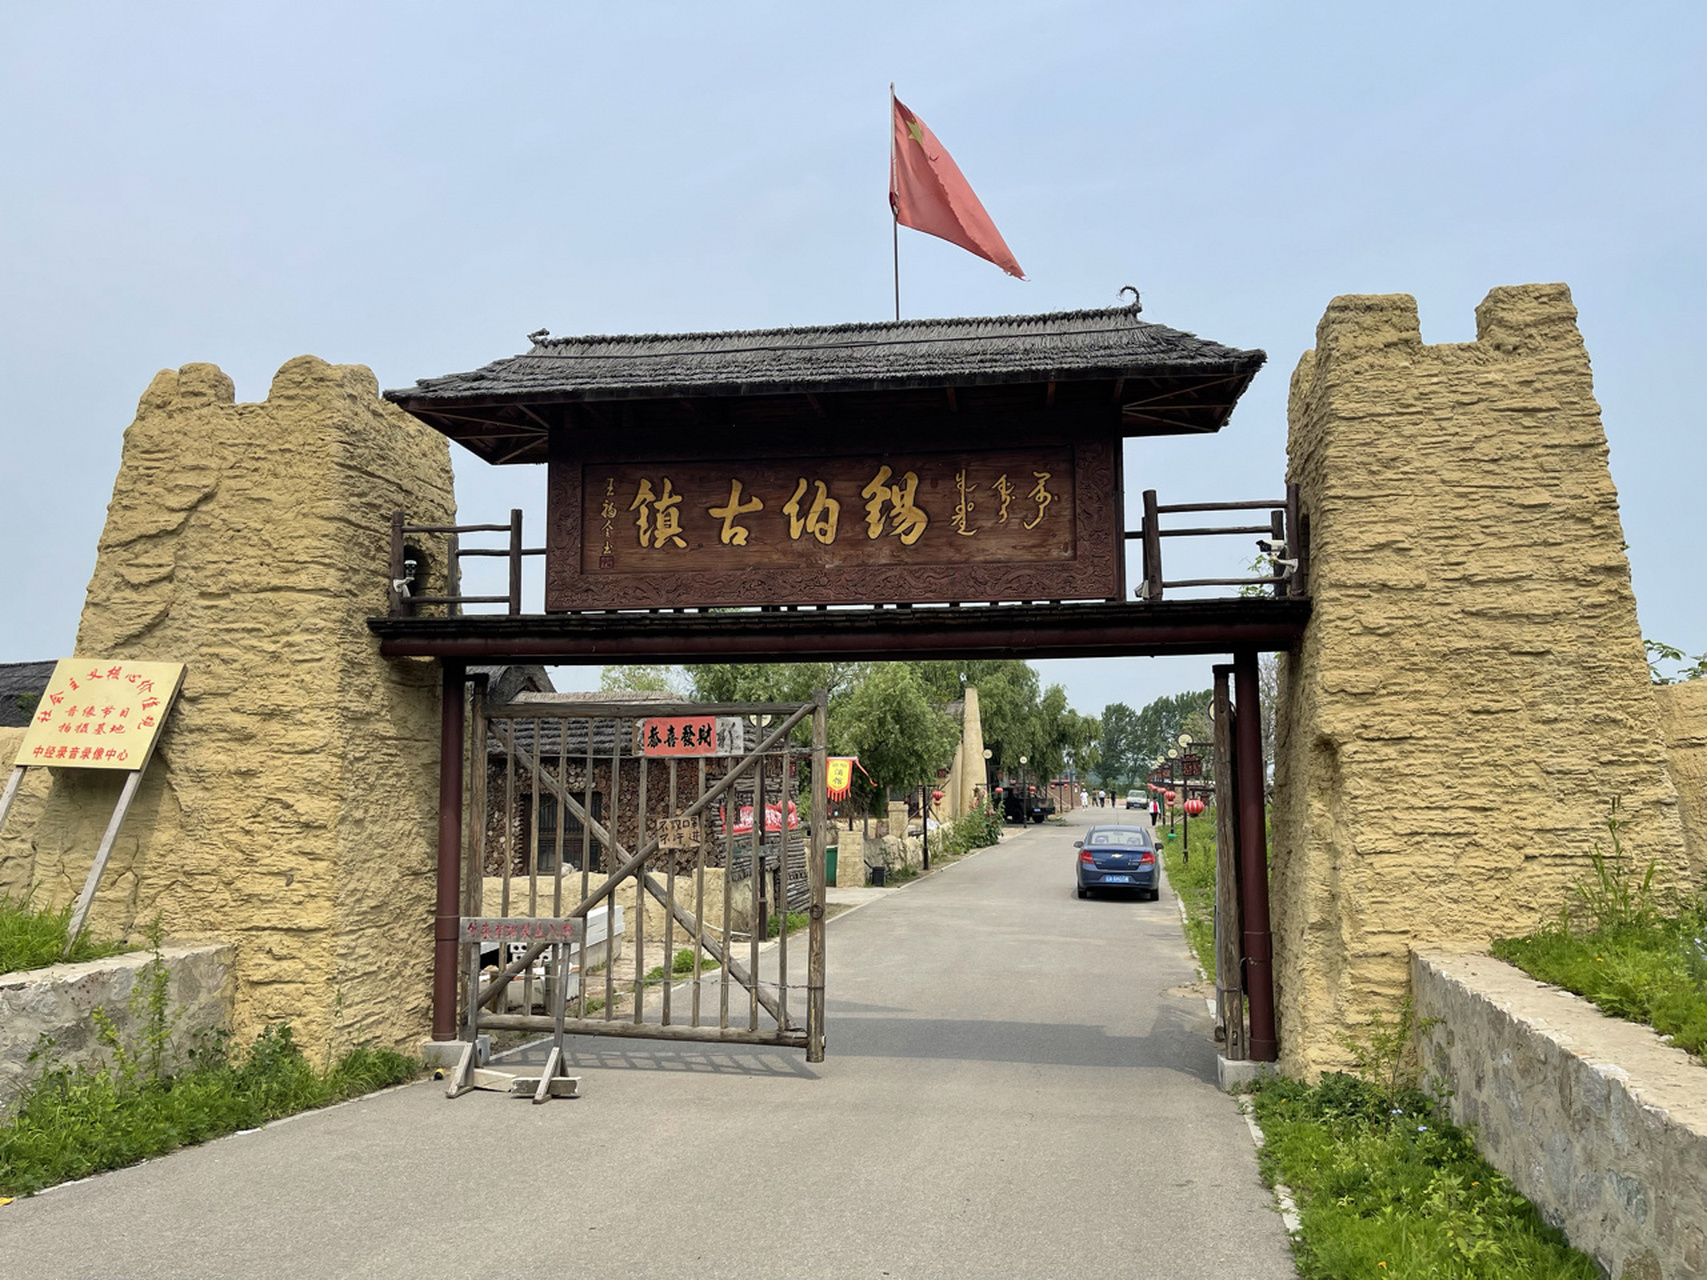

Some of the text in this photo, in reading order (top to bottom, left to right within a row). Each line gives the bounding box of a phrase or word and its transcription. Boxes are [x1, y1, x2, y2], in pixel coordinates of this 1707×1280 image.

[37, 665, 161, 731] 社会主义核心价值观
[64, 705, 131, 719] 音像节目
[57, 722, 127, 736] 拍摄基地
[32, 745, 129, 762] 中经录音录像中心
